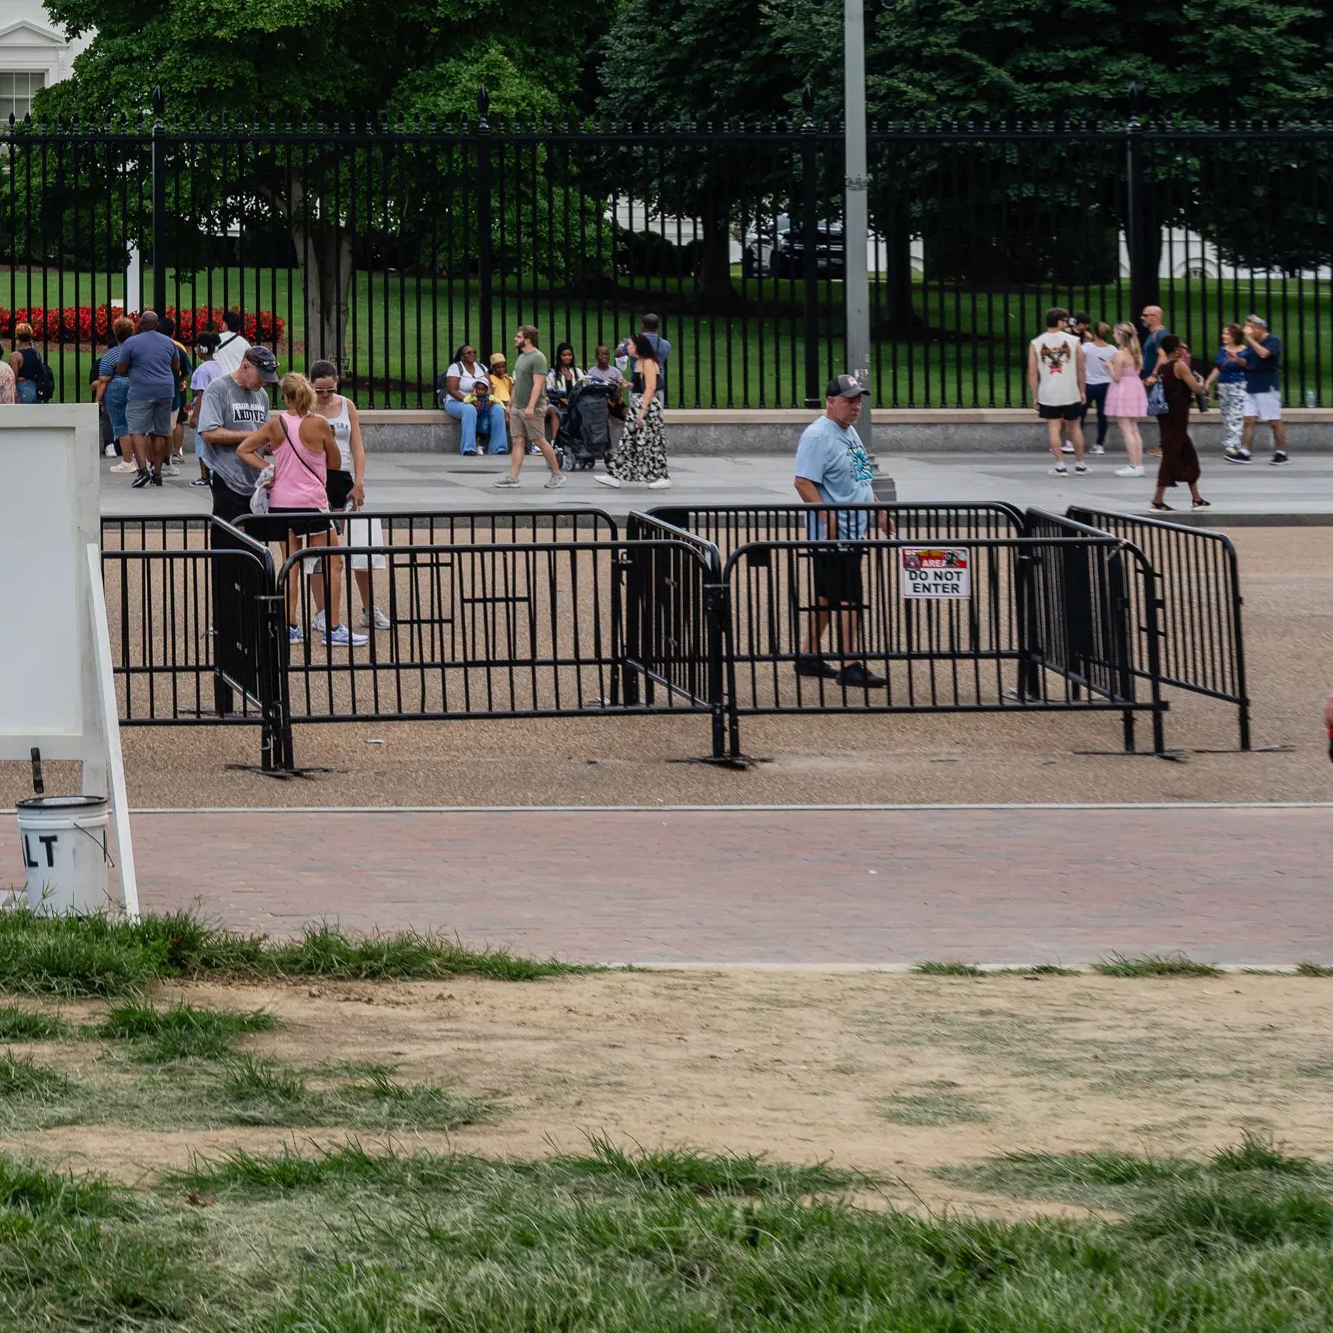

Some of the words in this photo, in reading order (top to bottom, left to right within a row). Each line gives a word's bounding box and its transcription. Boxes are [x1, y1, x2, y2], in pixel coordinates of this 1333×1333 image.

[909, 570, 929, 581] DO
[934, 570, 963, 581] NOT
[913, 583, 960, 594] ENTER
[21, 834, 58, 868] LT
